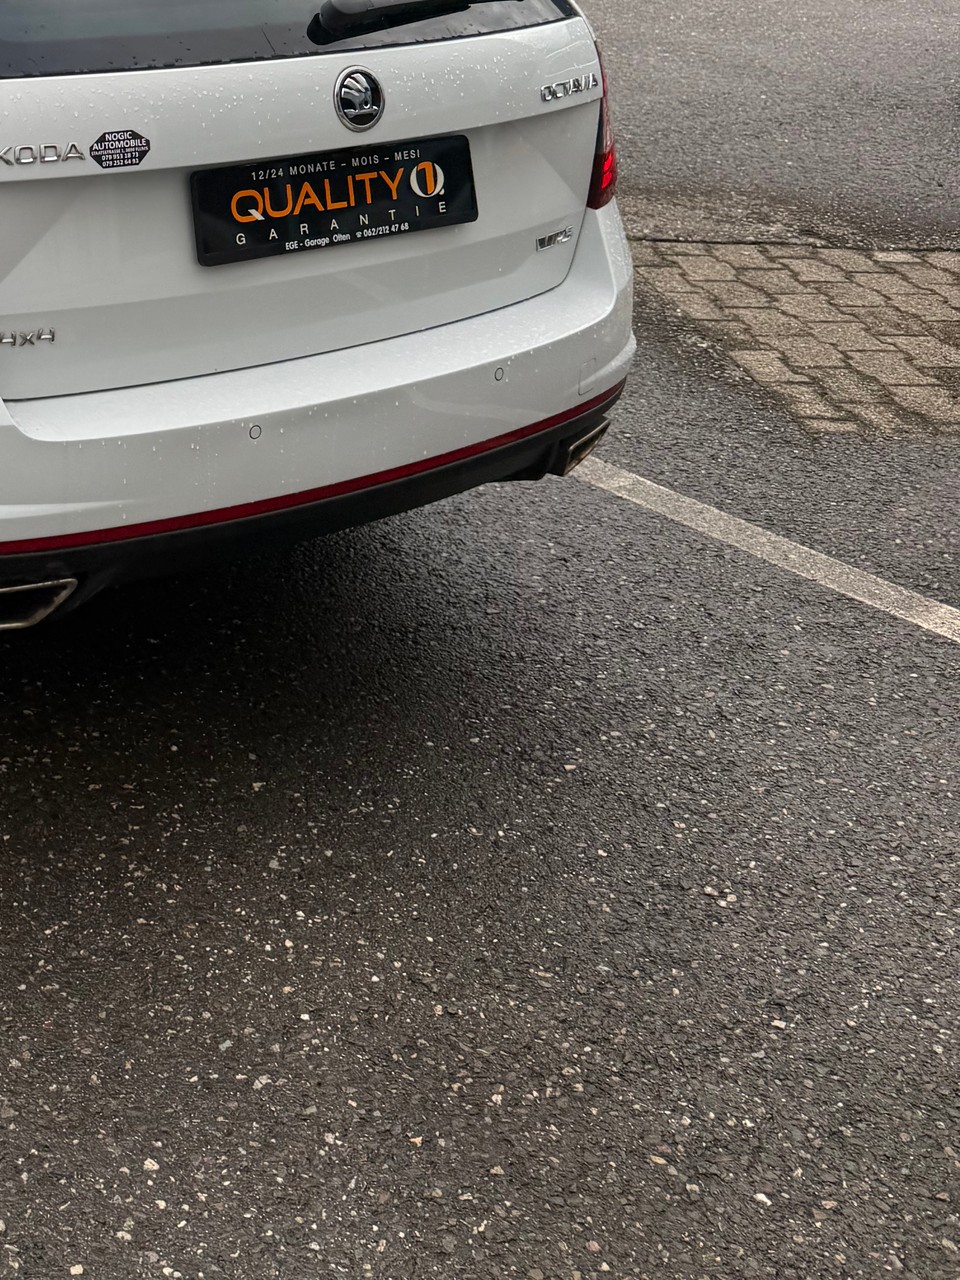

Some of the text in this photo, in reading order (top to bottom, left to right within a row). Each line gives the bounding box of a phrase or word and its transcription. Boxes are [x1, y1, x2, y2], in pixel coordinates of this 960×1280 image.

[540, 72, 599, 102] OCTAVIA
[92, 138, 147, 151] AUTOMOBILE
[105, 131, 133, 141] NOGIC
[251, 168, 284, 181] 12/24
[289, 160, 336, 176] MONATE
[351, 154, 380, 167] MOIS
[394, 149, 421, 161] MESI
[230, 167, 405, 223] QUALITY
[235, 201, 447, 245] GARANTIE
[285, 240, 299, 251] EGE
[304, 236, 330, 247] Garage
[332, 233, 351, 242] Olten
[363, 225, 390, 238] 062/212
[391, 223, 399, 232] 47
[400, 222, 409, 231] 68
